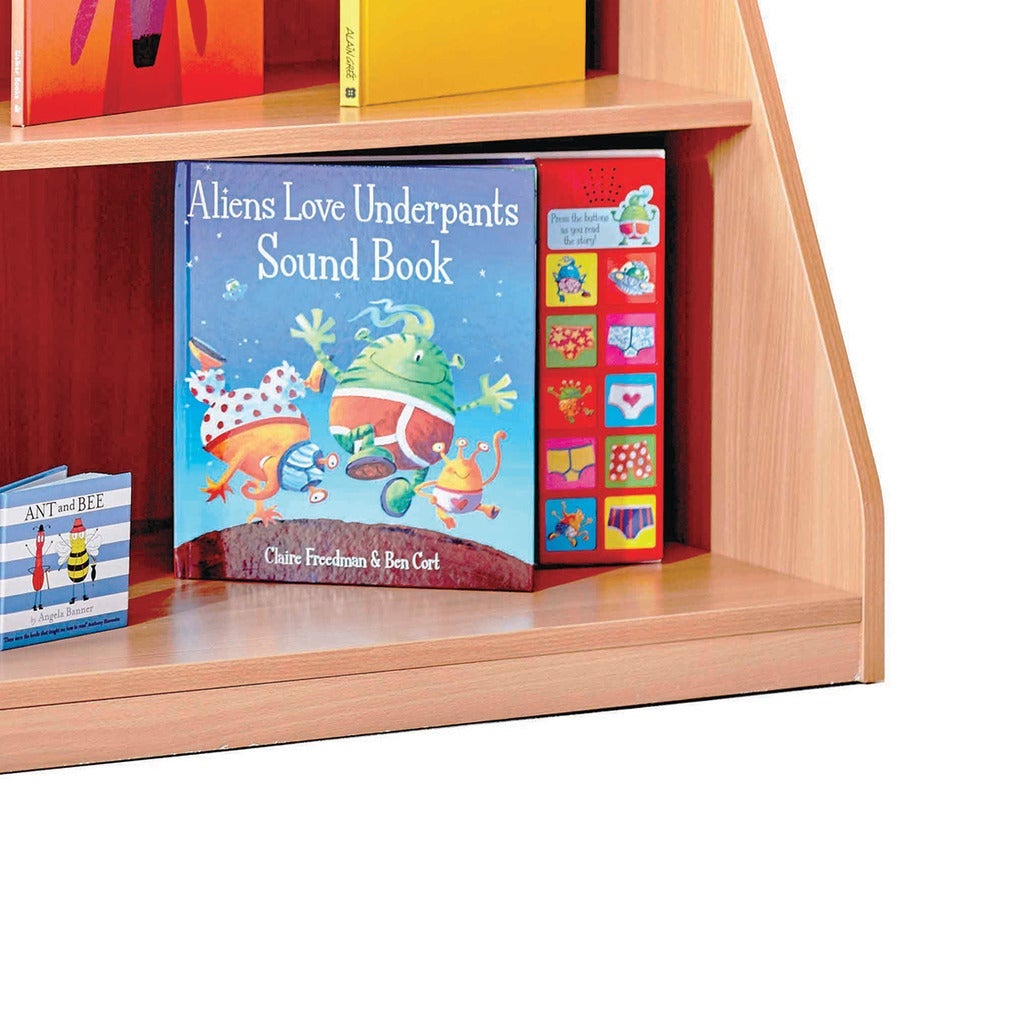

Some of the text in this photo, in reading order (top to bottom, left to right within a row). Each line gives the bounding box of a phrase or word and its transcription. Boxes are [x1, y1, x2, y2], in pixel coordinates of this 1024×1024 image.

[187, 179, 519, 233] Aliens Love Underpants
[571, 213, 582, 222] the
[570, 226, 583, 235] you
[584, 224, 600, 233] read
[563, 236, 575, 245] the
[257, 232, 454, 285] Sound Book
[24, 493, 105, 521] ANT and BEE
[264, 546, 440, 570] Claire Freedman & Ben Cort
[38, 609, 64, 623] Angela
[66, 605, 93, 617] Banner
